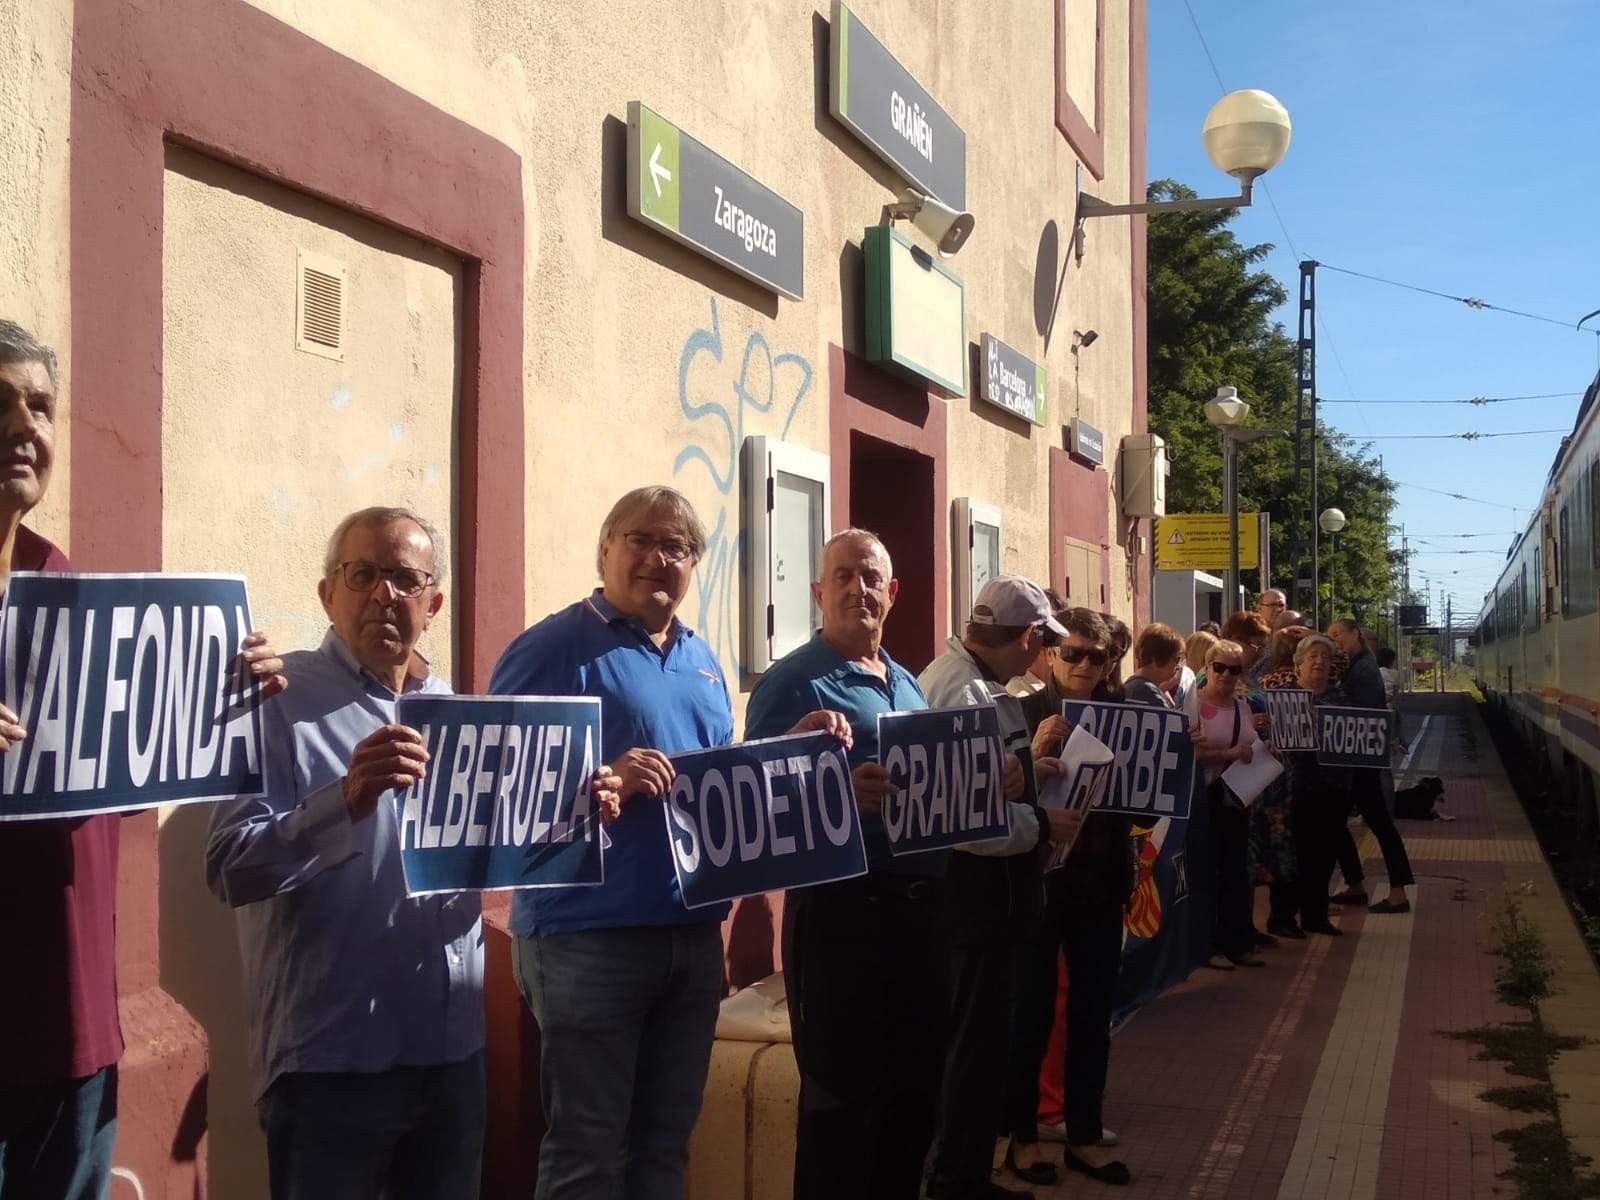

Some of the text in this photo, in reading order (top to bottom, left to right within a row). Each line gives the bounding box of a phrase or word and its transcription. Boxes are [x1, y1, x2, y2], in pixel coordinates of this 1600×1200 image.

[891, 91, 933, 163] GRAÑÉN
[714, 186, 777, 257] Zaragoza
[999, 361, 1026, 398] Barcelona
[1, 603, 260, 795] VALFONDA
[1322, 715, 1387, 755] ROBRES
[401, 724, 593, 850] ALBERUELA
[670, 750, 851, 874] SODETO
